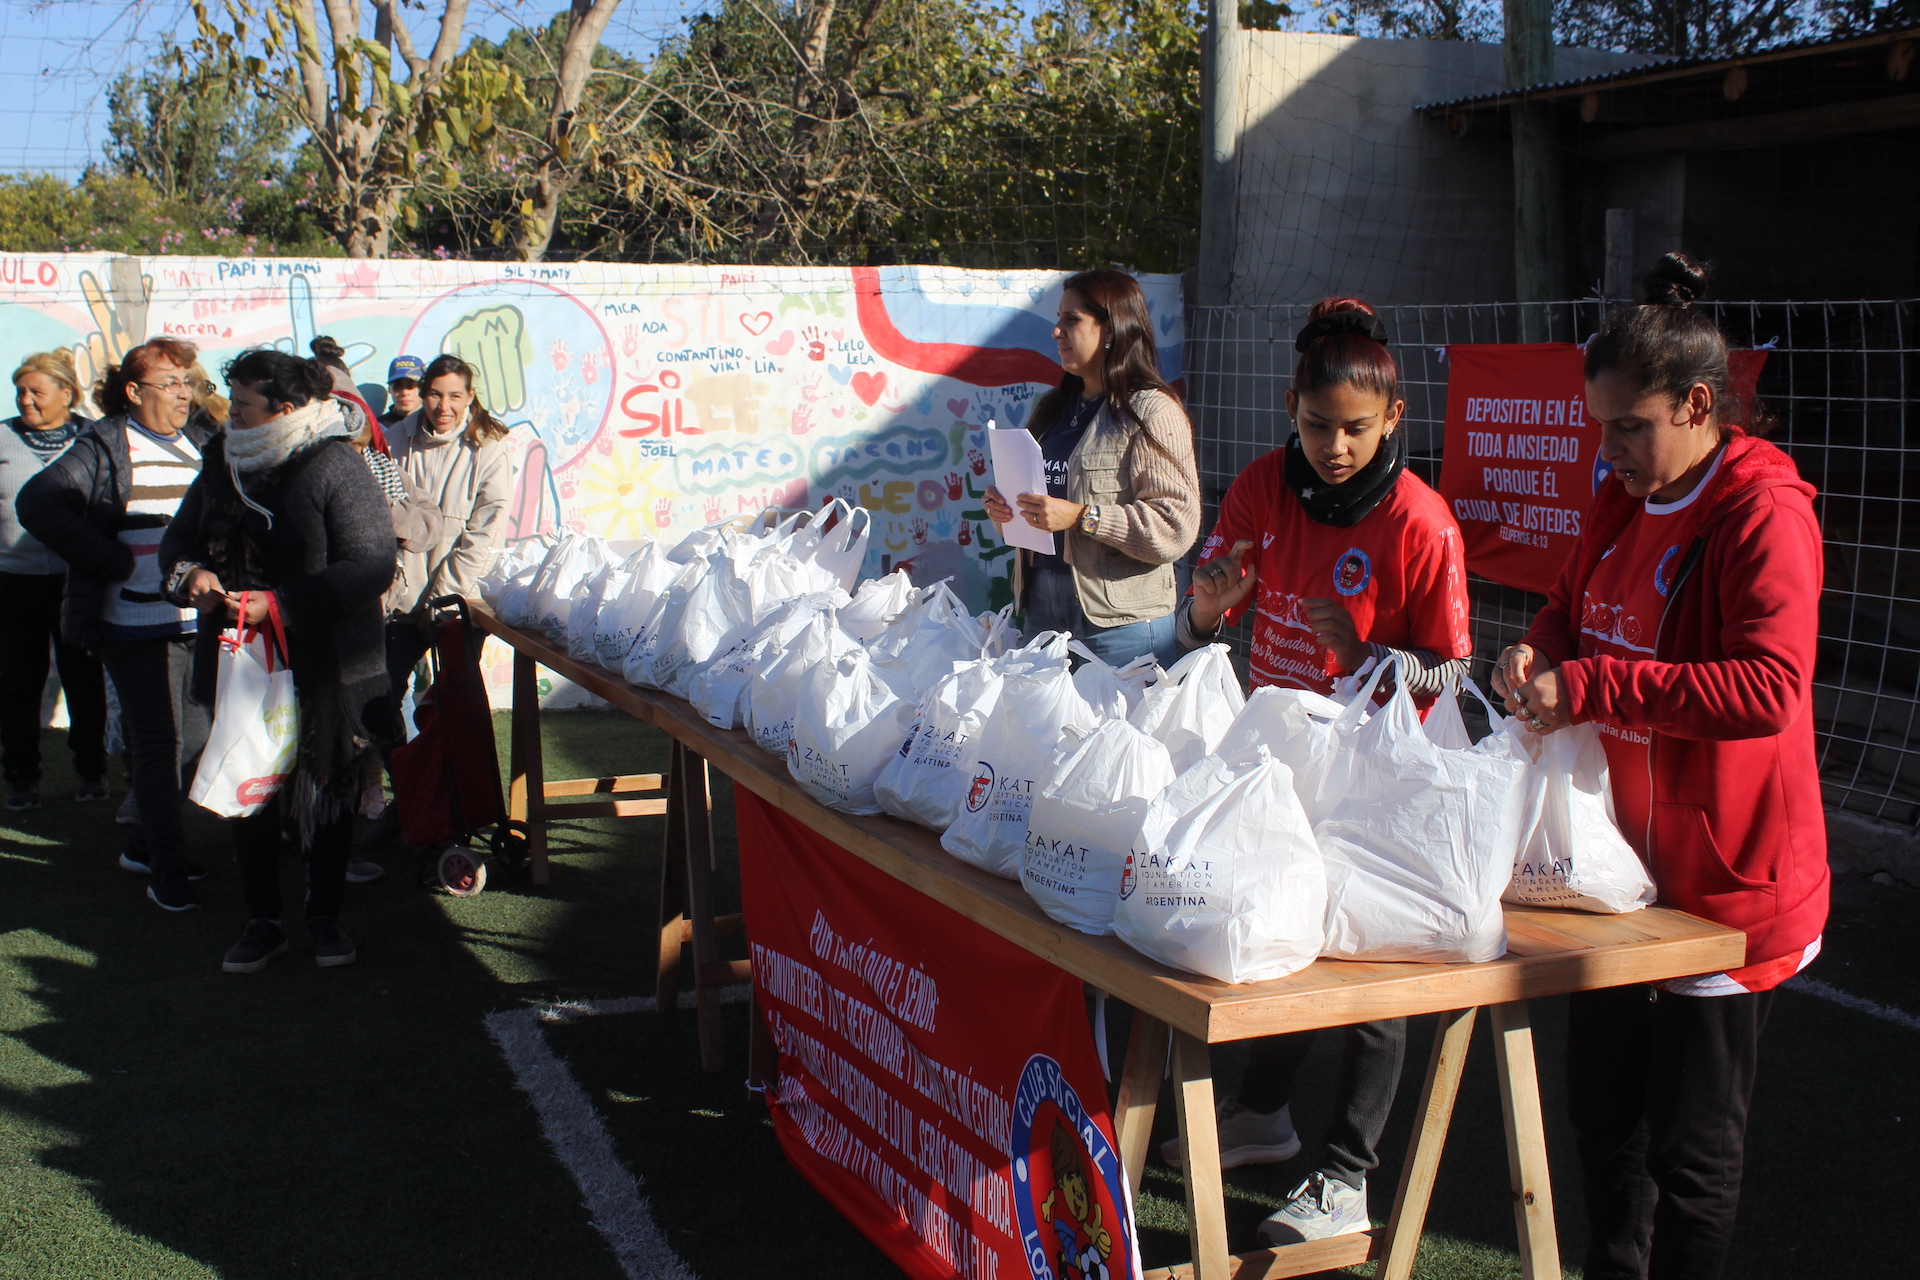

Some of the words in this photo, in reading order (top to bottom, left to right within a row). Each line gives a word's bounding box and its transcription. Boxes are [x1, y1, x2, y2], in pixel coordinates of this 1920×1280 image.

[604, 304, 640, 316] MICA
[163, 322, 219, 336] Karen
[1466, 397, 1542, 425] DEPOSITEN
[1545, 400, 1566, 426] EN
[1568, 395, 1586, 427] ÉL
[640, 445, 677, 458] JOEL
[1467, 432, 1502, 458] TODA
[1506, 434, 1579, 463] ANSIEDAD
[1483, 467, 1539, 496] PORQUE
[1543, 466, 1559, 498] ÉL
[1454, 499, 1502, 523] CUIDA
[1502, 501, 1520, 527] DE
[1523, 504, 1580, 536] USTEDES
[1532, 535, 1548, 549] 4:13
[1264, 625, 1317, 655] Merendero
[1264, 645, 1330, 682] Petaquitas
[924, 725, 969, 745] ZAAT
[999, 776, 1034, 793] KAT
[1025, 830, 1090, 862] ZAKAT
[1037, 860, 1084, 882] AMERICA
[1140, 852, 1214, 871] ZAKAT
[1025, 870, 1076, 896] ARGENTINA
[1146, 896, 1207, 906] ARGENTINA
[1518, 893, 1585, 903] ARGENTINA
[885, 961, 905, 1015] EL
[1017, 1061, 1047, 1128] CLUB
[1046, 1062, 1106, 1176] SOCIAL
[839, 1056, 876, 1129] PRECIOSO
[877, 1087, 888, 1140] DE
[889, 1096, 900, 1150] LO
[918, 1119, 947, 1187] SERÁS
[947, 1140, 973, 1208] COMO
[974, 1159, 986, 1218] MI
[987, 1168, 1014, 1240] BOCA.
[907, 1184, 961, 1274] CONVIERTAS
[963, 1228, 970, 1280] A
